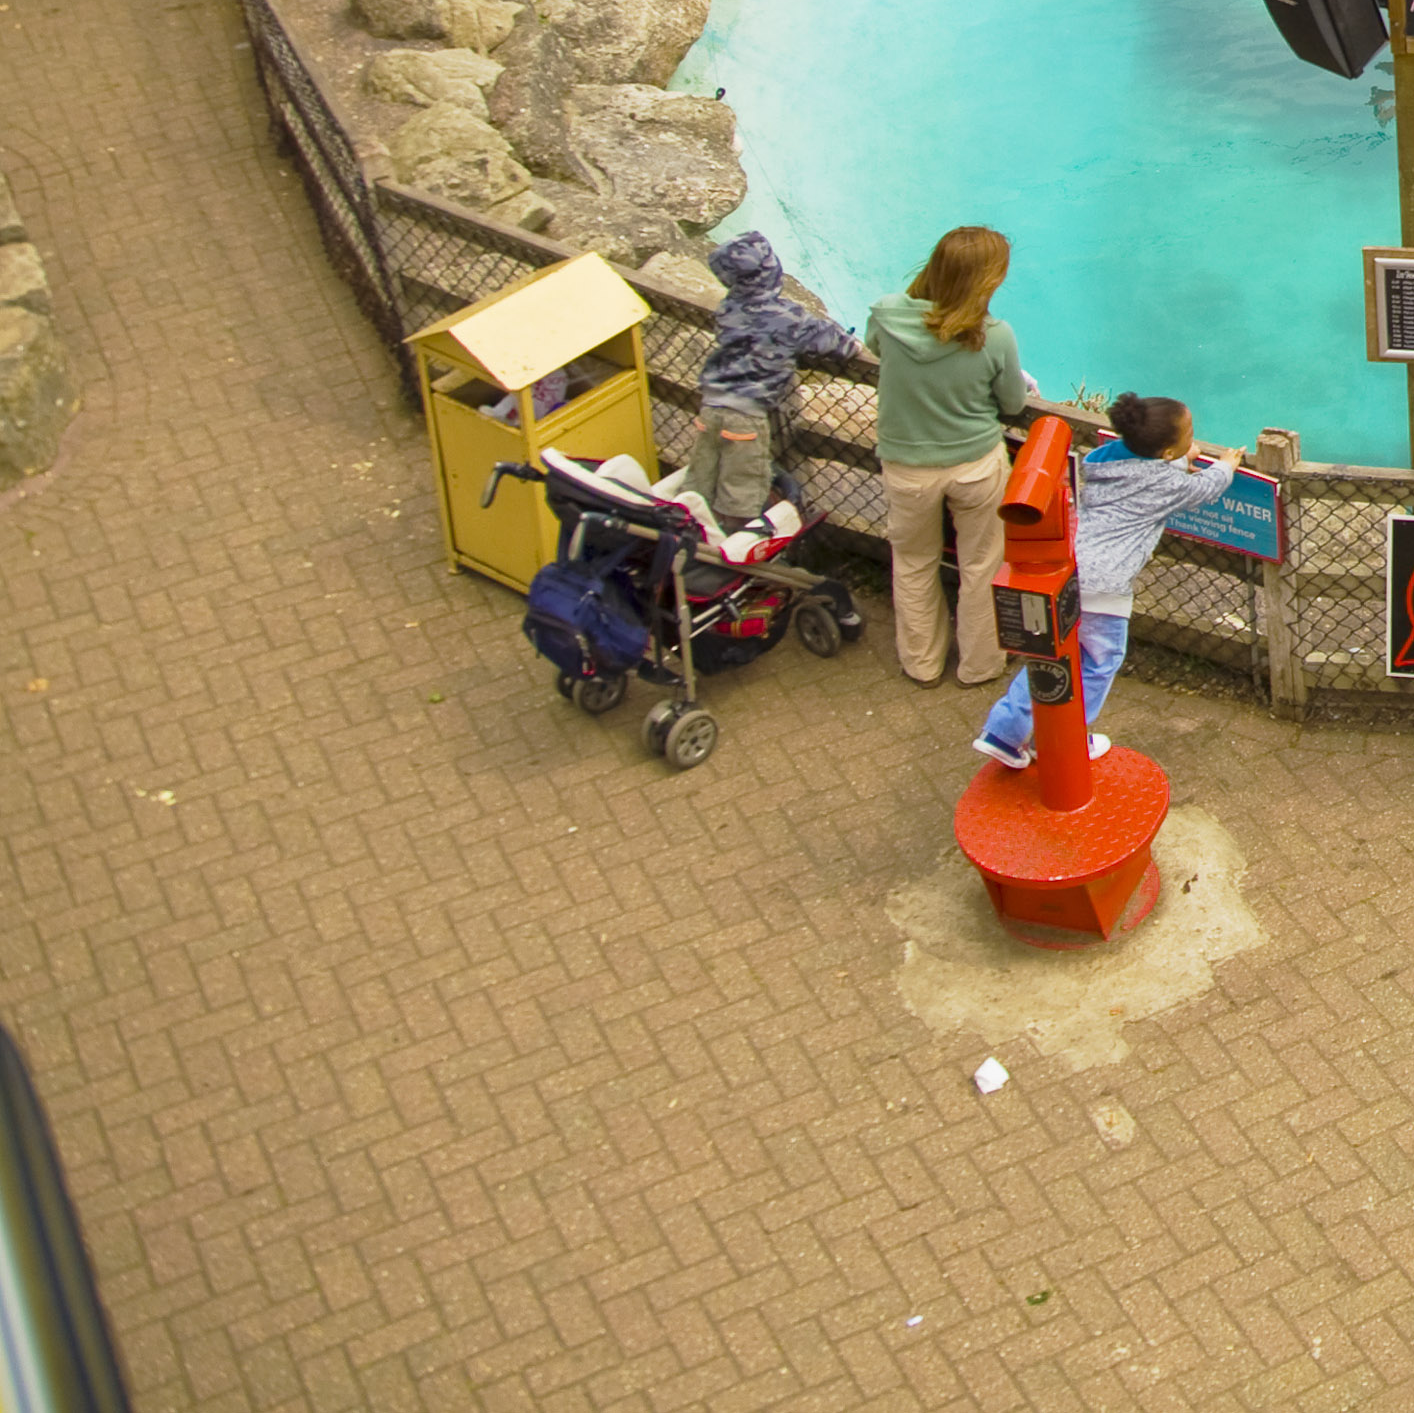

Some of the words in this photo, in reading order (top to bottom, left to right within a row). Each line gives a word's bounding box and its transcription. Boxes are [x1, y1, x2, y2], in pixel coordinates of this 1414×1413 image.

[1202, 509, 1219, 519] not
[1222, 497, 1272, 523] WATER
[1168, 517, 1199, 532] Thank
[1200, 526, 1219, 538] You
[1189, 514, 1226, 532] viewing
[1228, 524, 1256, 540] fence
